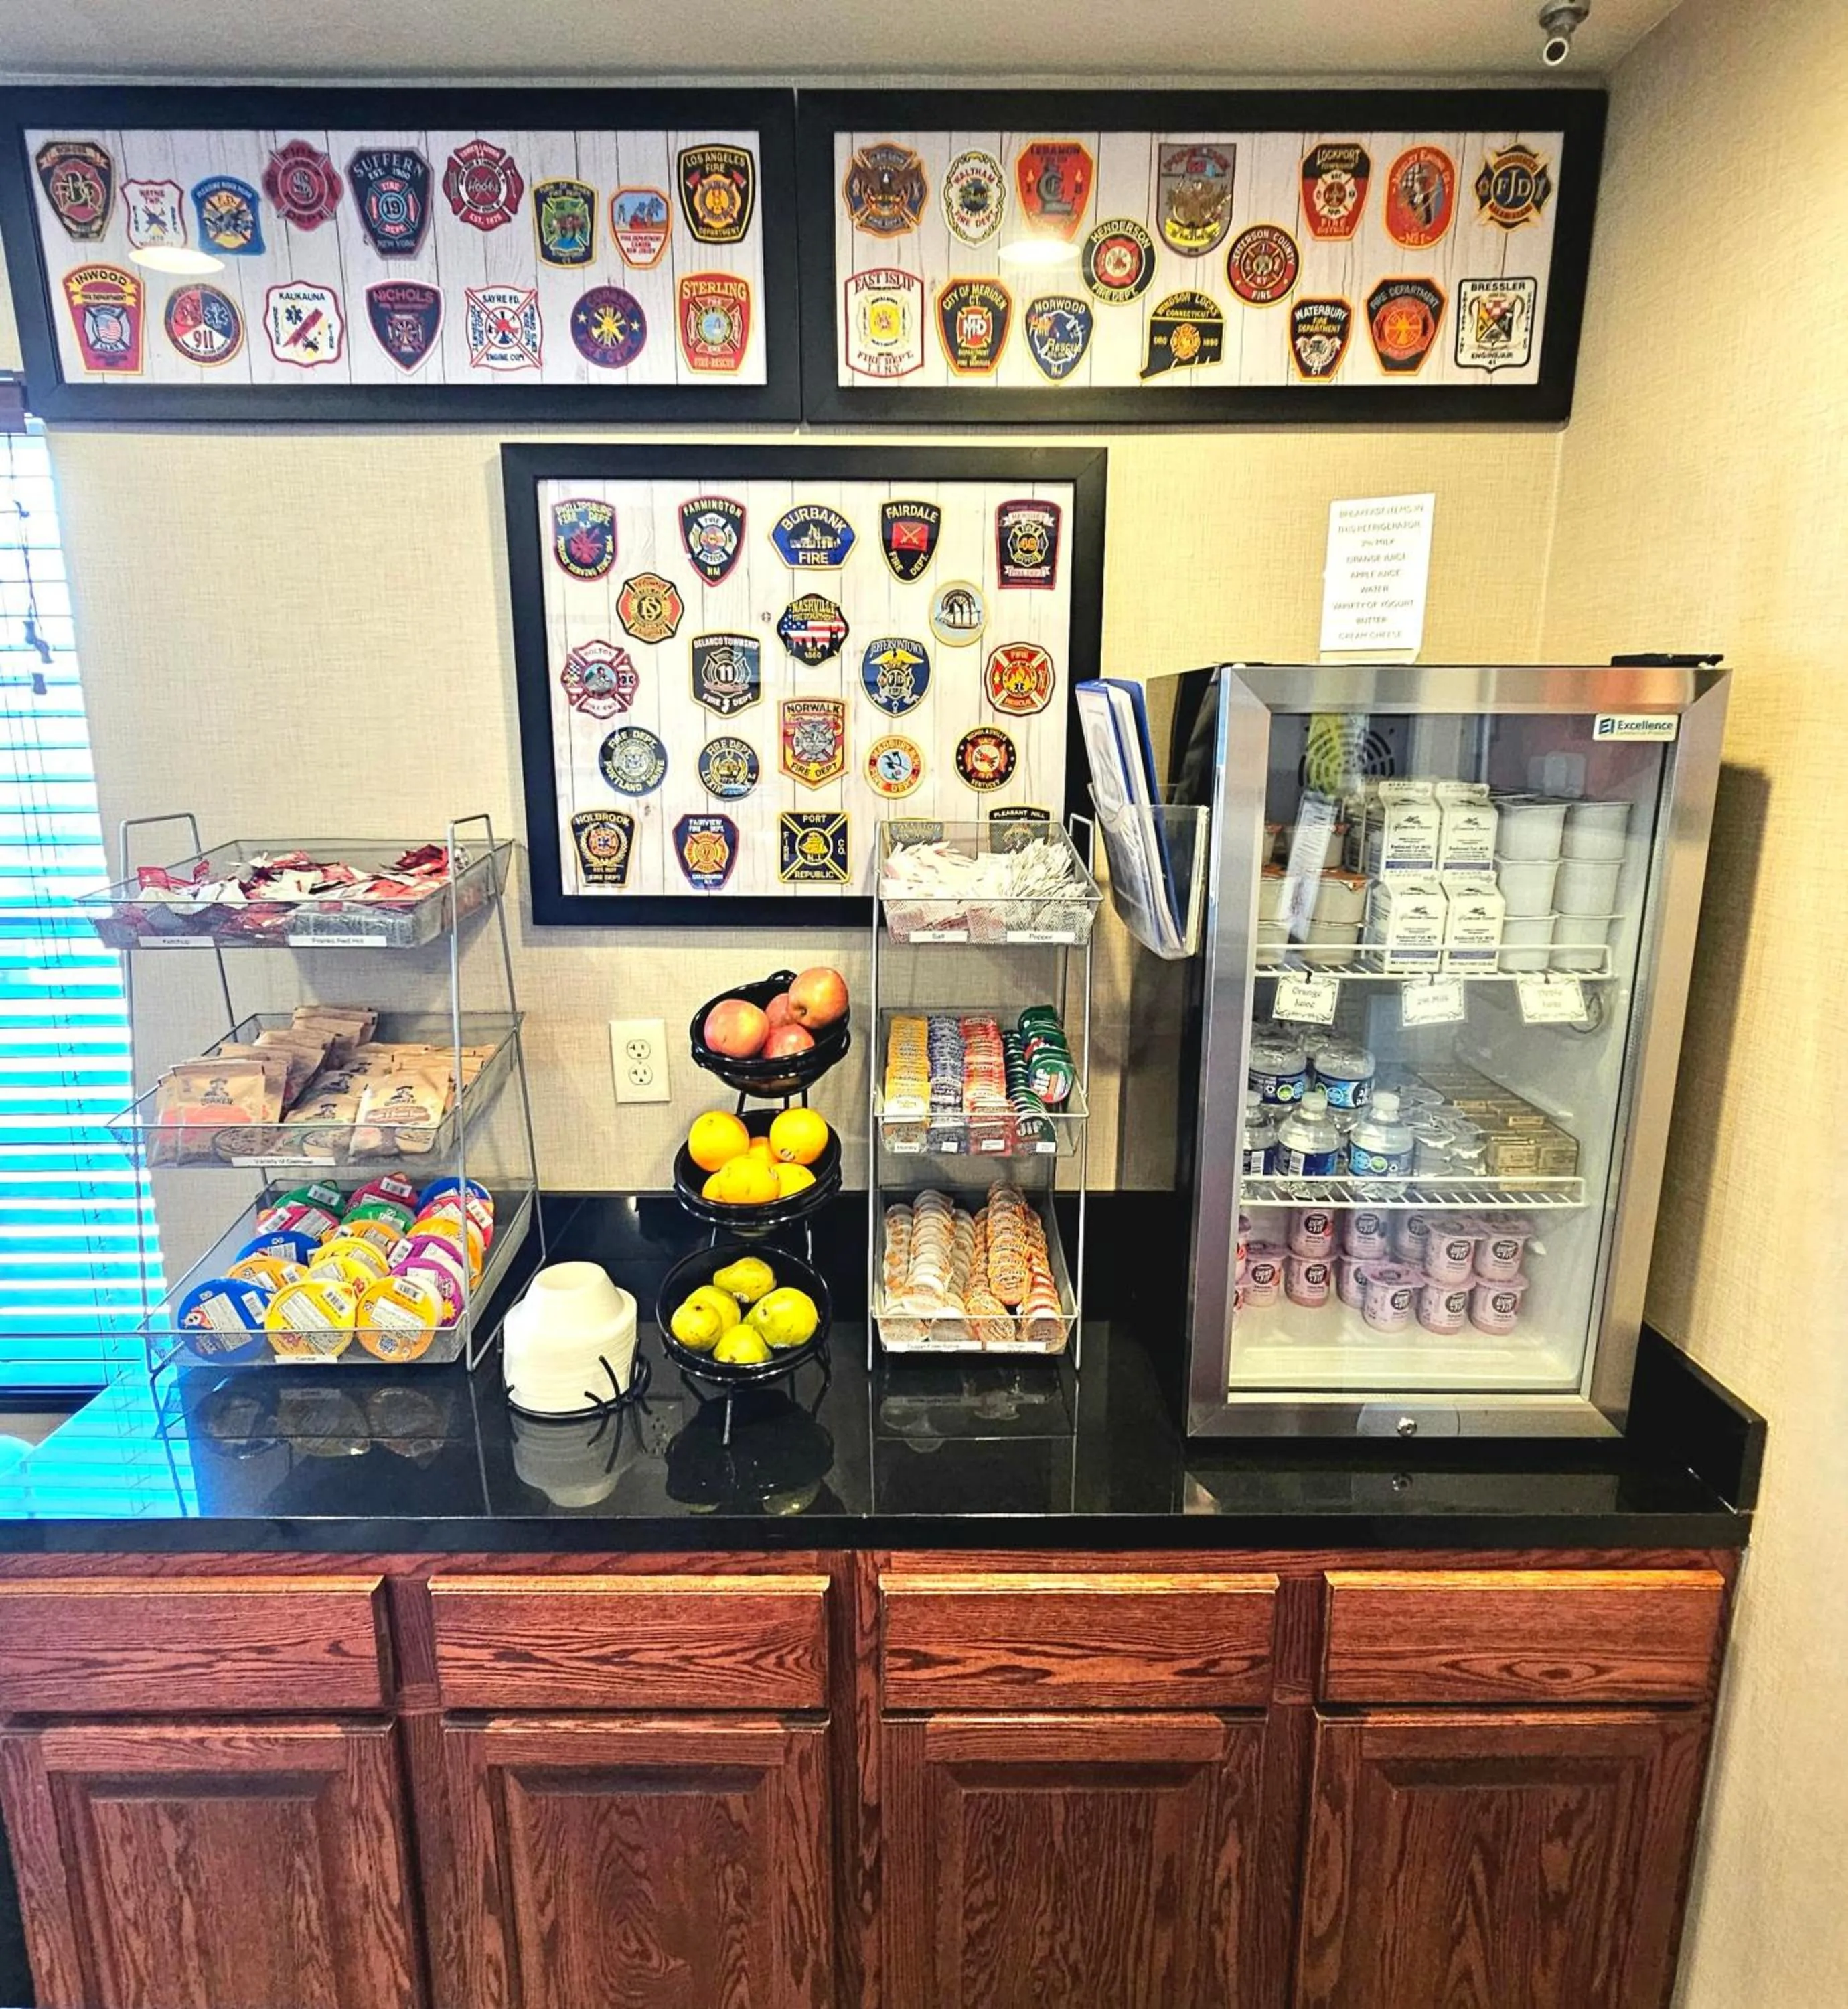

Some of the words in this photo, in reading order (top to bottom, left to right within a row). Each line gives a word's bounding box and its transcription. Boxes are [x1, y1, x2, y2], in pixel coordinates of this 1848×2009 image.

[686, 155, 704, 166] LOS
[705, 153, 745, 165] ANGELES
[1316, 148, 1361, 165] LOCKPORT
[353, 153, 425, 177] SUFFERN
[706, 164, 725, 173] FIRE
[953, 167, 995, 184] WALTHAM
[384, 200, 400, 214] 19
[955, 213, 970, 226] FIRE
[698, 227, 739, 236] DEPARTMENT
[1091, 222, 1151, 248] HENDERSON
[1273, 233, 1294, 265] COUNTY
[76, 269, 127, 287] INWOOD
[855, 273, 882, 293] EAST
[884, 273, 915, 291] ISLIP
[683, 281, 747, 299] STERLING
[1471, 283, 1526, 291] BRESSLER
[373, 288, 434, 302] NICHOLS
[483, 294, 506, 305] SAYRE
[943, 290, 959, 309] CITY
[959, 287, 970, 299] OF
[972, 284, 1007, 310] MERIDEN
[1251, 291, 1272, 299] FIRE
[1370, 293, 1387, 310] FIRE
[1389, 285, 1440, 309] DEPARTMENT
[1035, 299, 1085, 313] NORWOOD
[1166, 309, 1209, 317] CONNECTICUT
[1294, 305, 1349, 321] WATERBURY
[1298, 323, 1341, 334] DEPARTMENT
[193, 330, 214, 348] 911
[857, 351, 879, 364] FIRE
[1050, 365, 1062, 376] NJ
[683, 500, 742, 518] FARMINGTON
[886, 505, 939, 523] FAIRDALE
[781, 507, 847, 533] BURBANK
[799, 552, 828, 564] FIRE
[889, 550, 903, 573] FIRE
[910, 554, 929, 575] DEPT.
[1346, 556, 1380, 564] ORANGE
[706, 567, 721, 576] NM
[1351, 571, 1375, 579] APPLE
[1361, 585, 1389, 593] WATER
[792, 599, 835, 614] NASHVILLE
[1381, 600, 1413, 608] YOGURT
[1356, 616, 1387, 624] BUTTER
[1338, 632, 1367, 640] CREAM
[1369, 631, 1401, 639] CHEESE
[694, 639, 722, 648] DELANCO
[723, 638, 759, 648] TOWNSHIP
[719, 666, 733, 682] 11
[702, 694, 720, 706] FIRE
[730, 694, 753, 707] DEPT
[787, 704, 840, 714] NORWALK
[1617, 720, 1673, 730] Excellence
[608, 731, 628, 749] FIRE
[706, 740, 728, 755] FIRE
[604, 760, 643, 793] PORTLAND
[649, 759, 665, 788] MAINE
[791, 763, 810, 777] FIRE
[816, 763, 838, 777] DEPT
[575, 813, 629, 826] HOLBROOK
[803, 815, 826, 823] PORT
[994, 810, 1028, 818] PLEASANT
[794, 871, 834, 879] REPUBLIC
